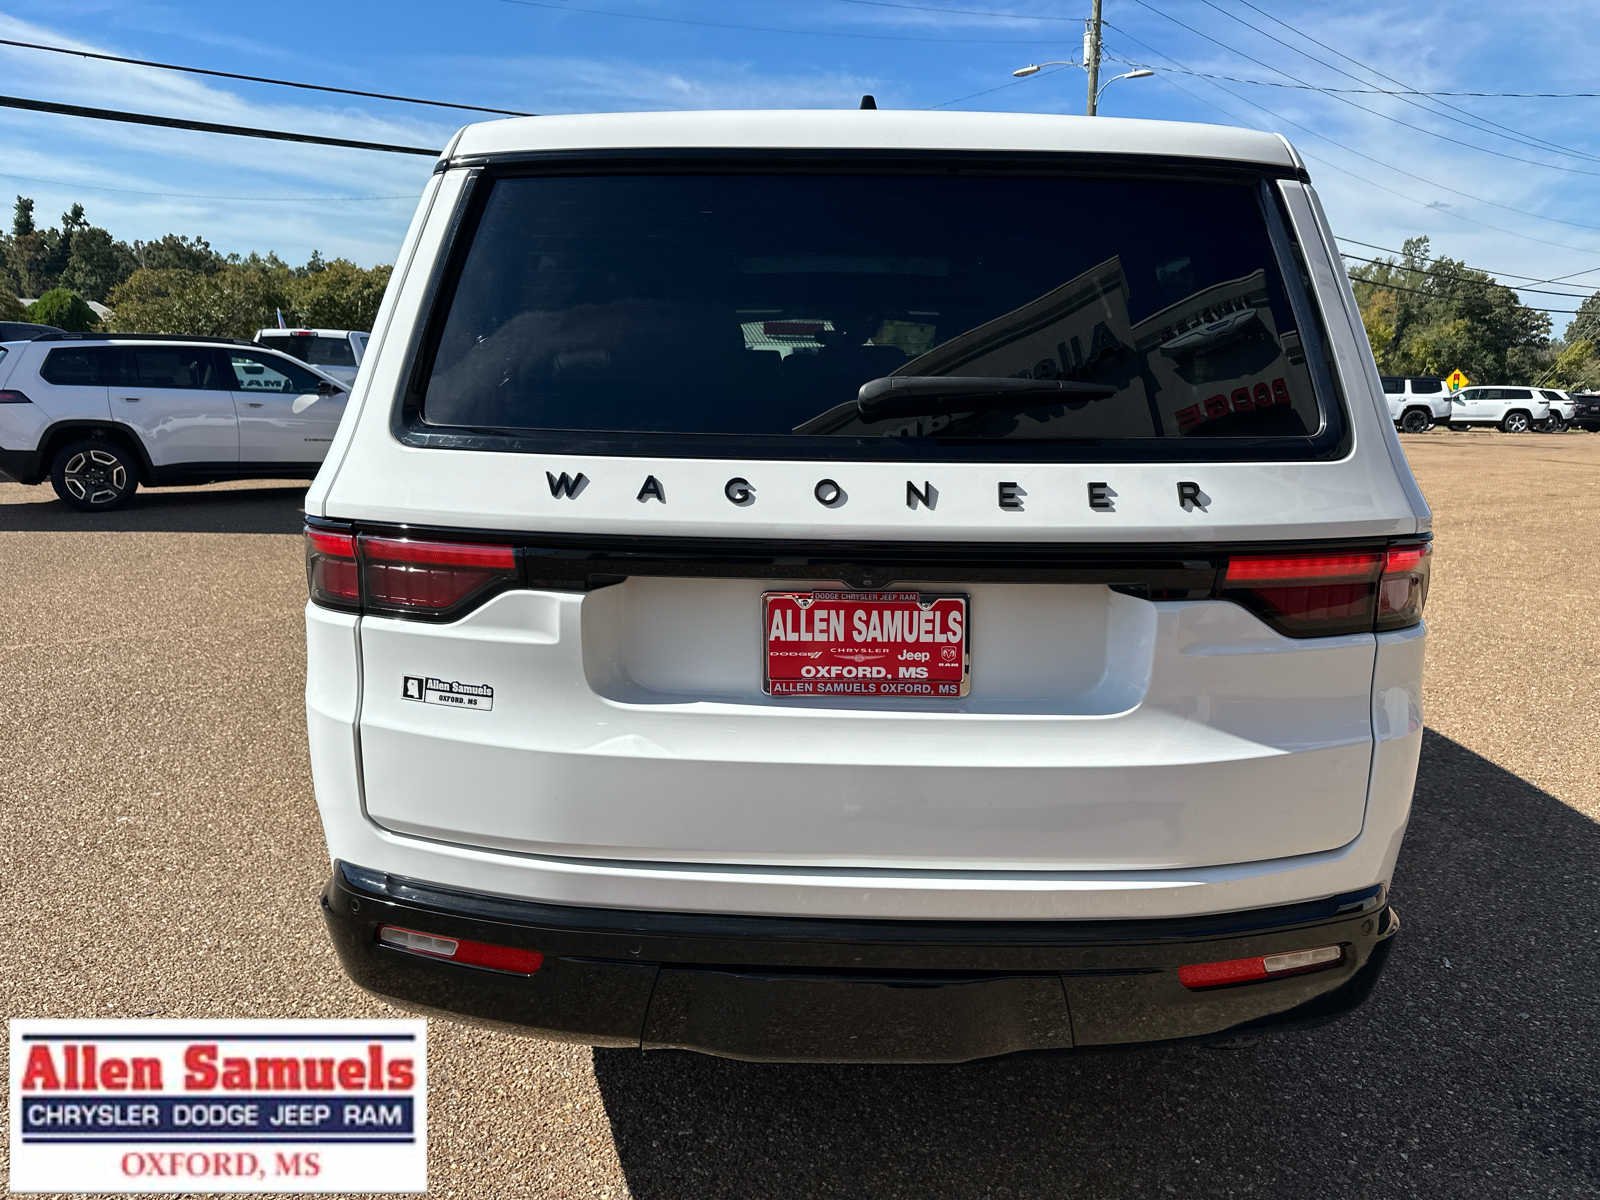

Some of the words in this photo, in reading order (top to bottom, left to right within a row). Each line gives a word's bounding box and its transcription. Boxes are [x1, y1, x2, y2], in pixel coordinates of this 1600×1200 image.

[546, 470, 1211, 512] WAGONEER
[841, 593, 878, 601] CHRYSLER
[769, 609, 844, 642] ALLEN
[852, 609, 963, 643] SAMUELS
[898, 649, 930, 663] Jeep
[801, 666, 892, 679] OXFORD,
[898, 666, 928, 679] MS
[427, 680, 450, 691] Allen
[452, 682, 493, 696] Samuels
[774, 682, 813, 692] ALLEN
[817, 683, 876, 693] SAMUELS
[880, 683, 934, 694] OXFORD,
[939, 684, 958, 694] MS
